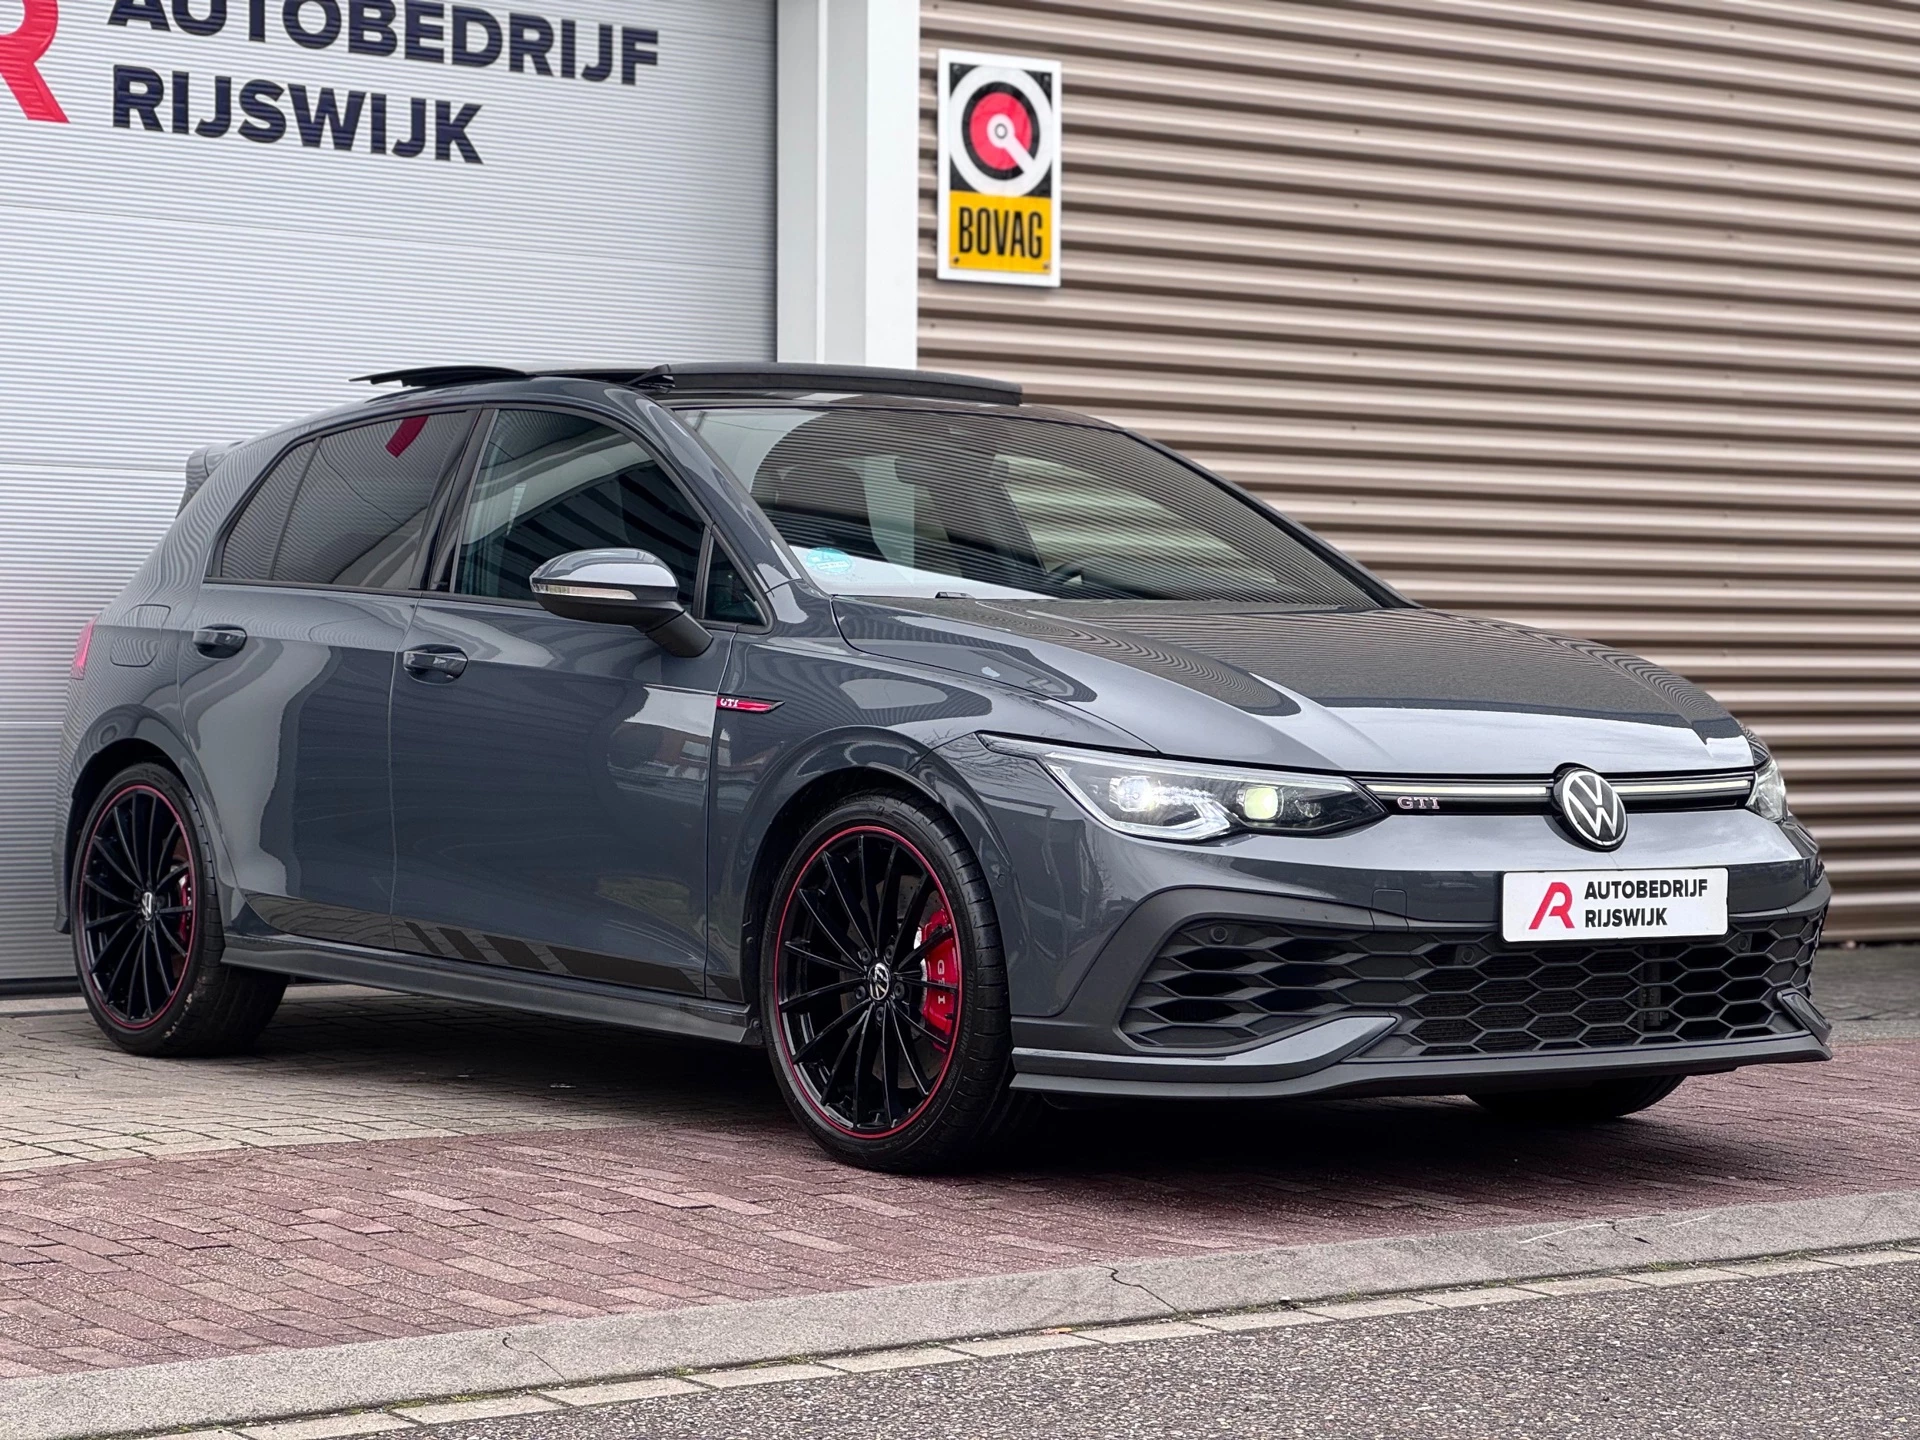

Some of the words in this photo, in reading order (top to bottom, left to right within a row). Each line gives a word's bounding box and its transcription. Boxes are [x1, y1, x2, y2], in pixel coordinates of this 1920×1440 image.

[112, 65, 484, 164] RIJSWIJK
[959, 207, 1043, 259] BOVAG
[720, 698, 739, 707] GTI
[1397, 796, 1440, 810] GTI
[1584, 879, 1708, 899] AUTOBEDRIJF
[1585, 907, 1668, 928] RIJSWIJK
